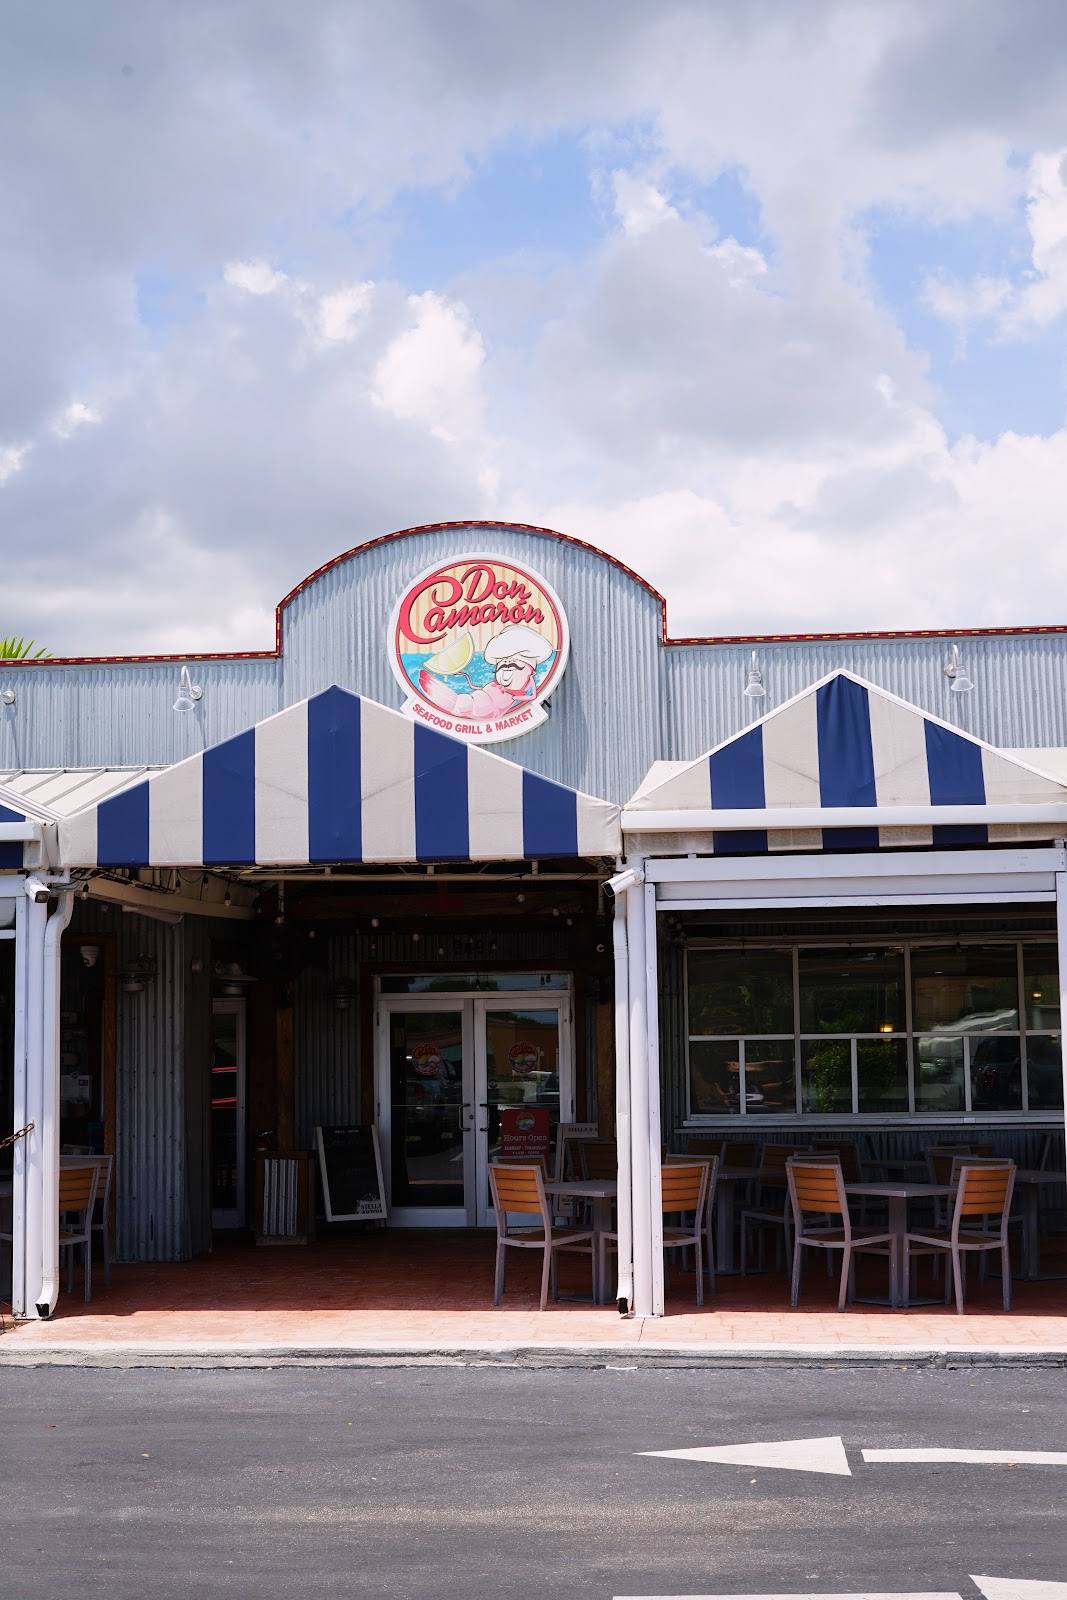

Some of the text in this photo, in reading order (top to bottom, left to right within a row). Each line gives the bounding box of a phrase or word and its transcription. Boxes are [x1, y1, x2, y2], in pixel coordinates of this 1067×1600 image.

[460, 565, 532, 604] Don
[399, 575, 545, 645] Camarón
[412, 703, 534, 734] SEAFOOD GRILL & MARKET
[503, 1134, 548, 1143] Hours Open
